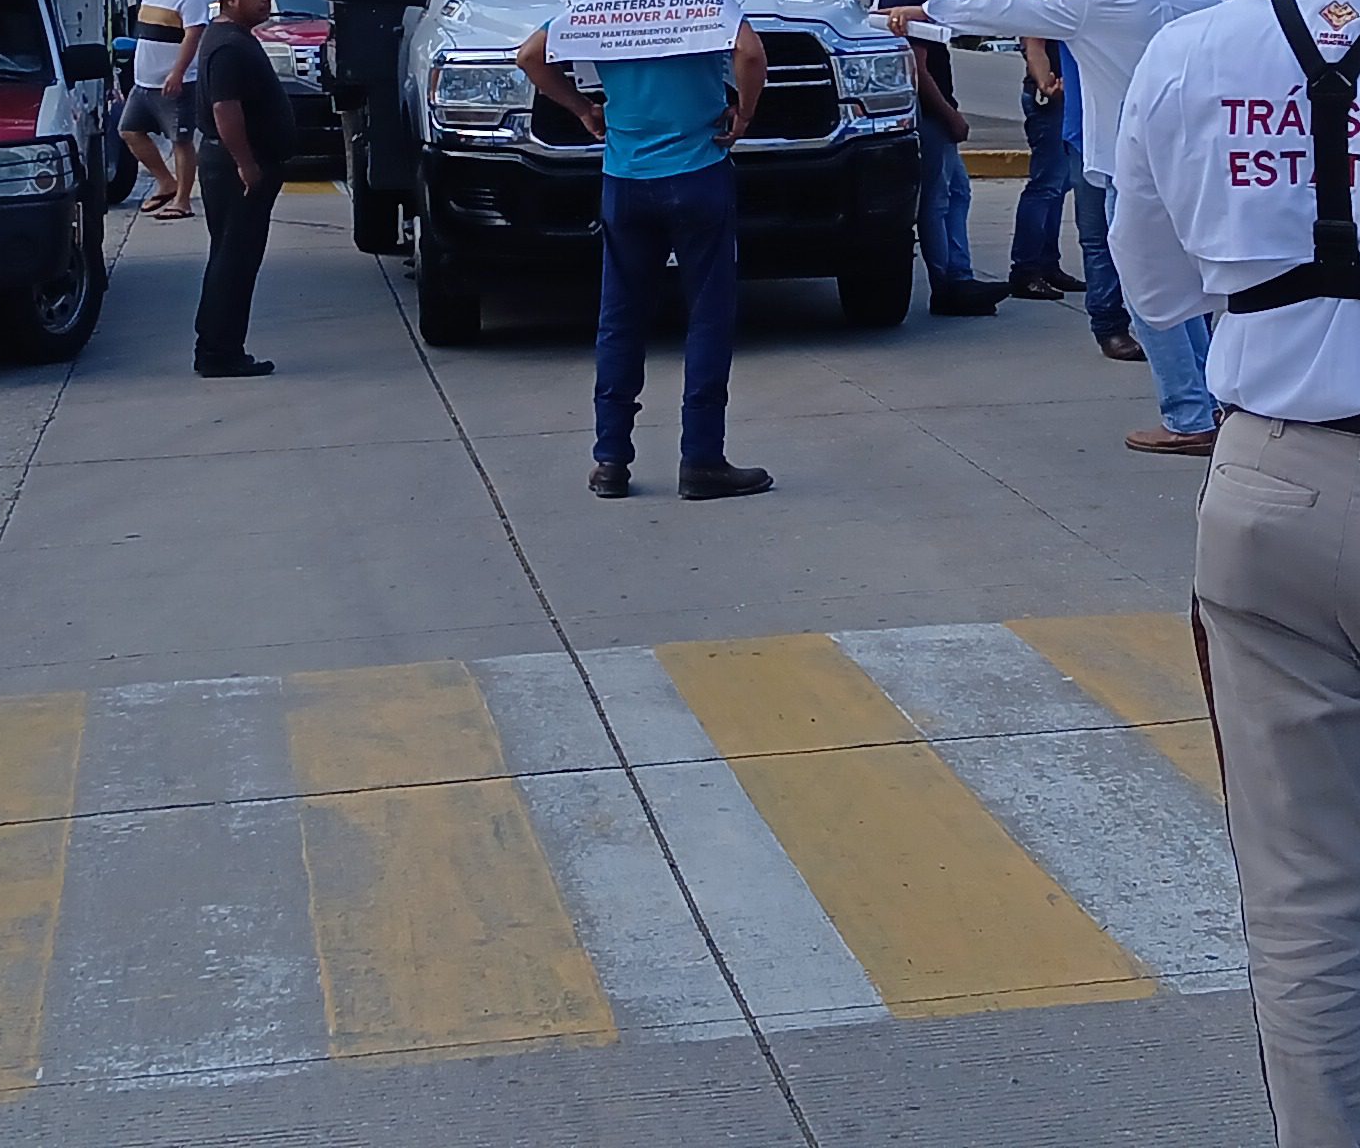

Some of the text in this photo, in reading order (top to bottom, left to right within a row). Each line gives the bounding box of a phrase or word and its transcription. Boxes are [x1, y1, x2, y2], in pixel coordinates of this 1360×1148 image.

[570, 4, 722, 25] PARA MOVER AL PAÍS!
[559, 31, 600, 40] EXIGIMOS
[602, 27, 672, 38] MANTENIMIENTO
[600, 41, 613, 49] NO
[614, 38, 633, 47] MÁS
